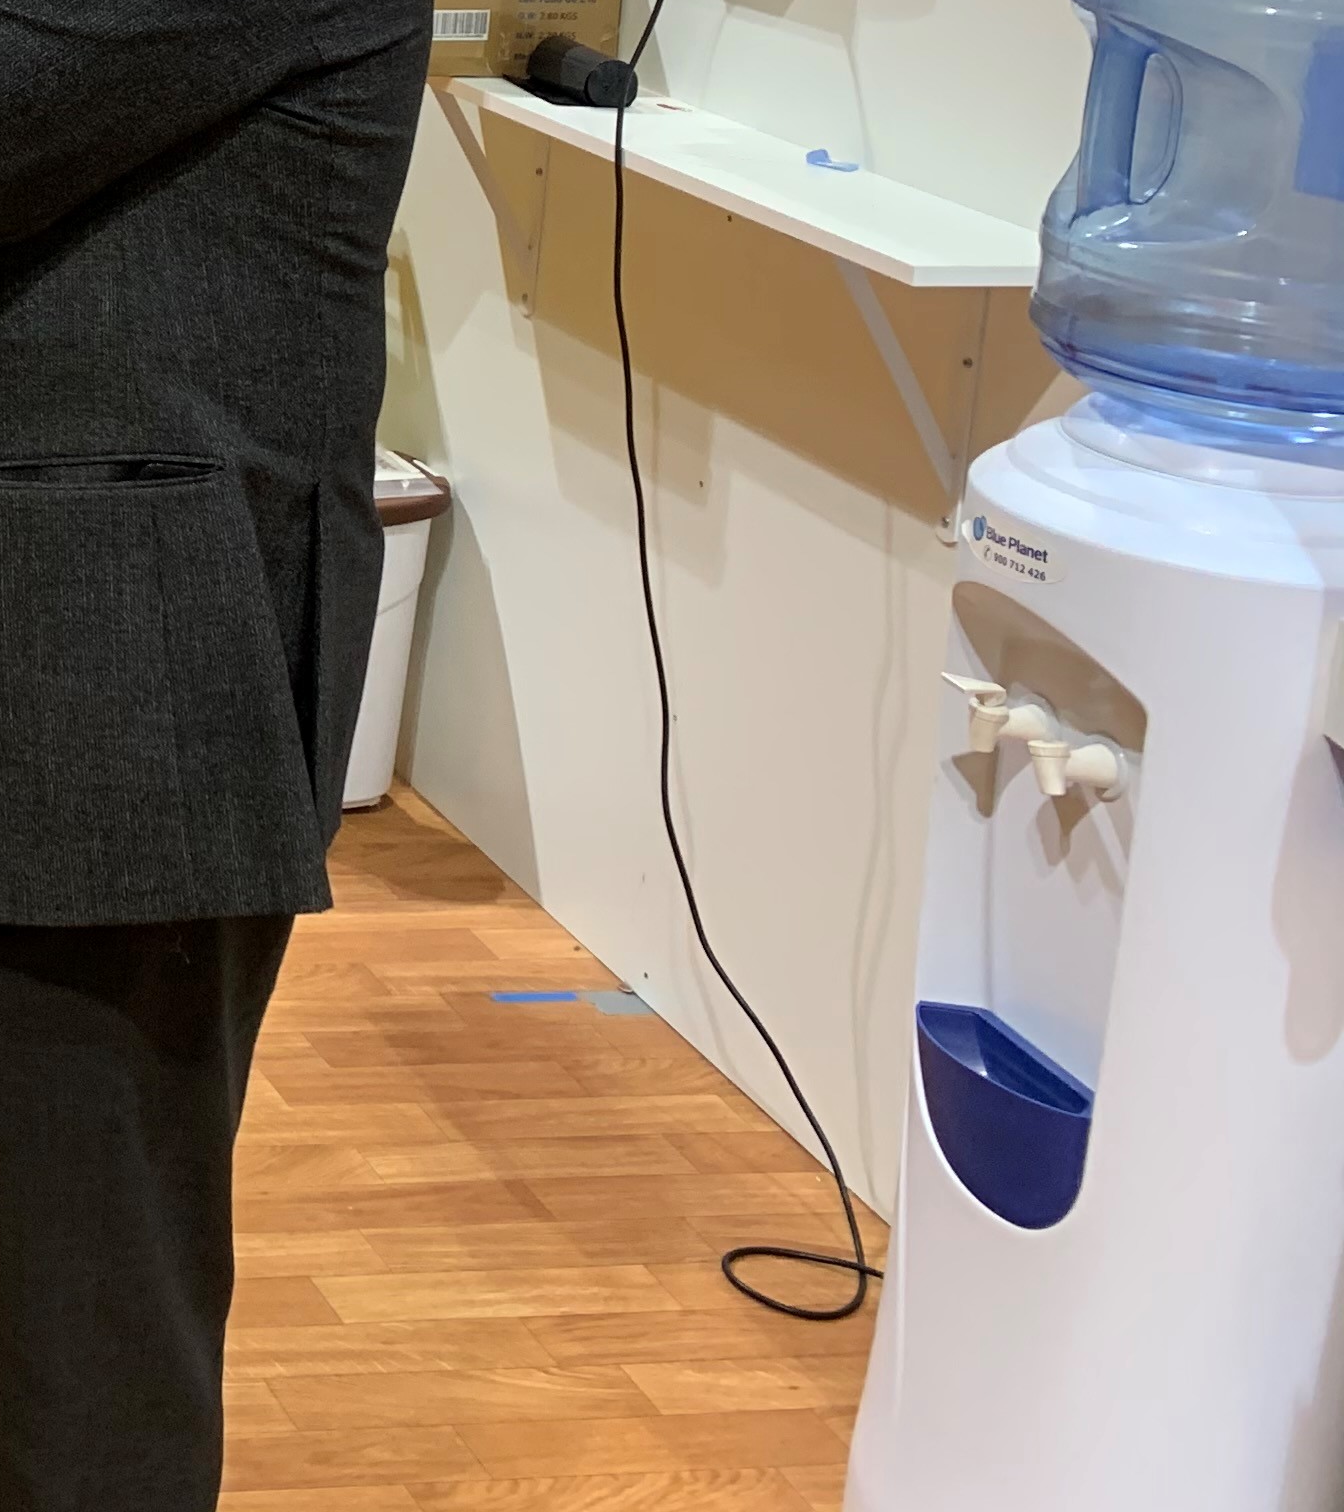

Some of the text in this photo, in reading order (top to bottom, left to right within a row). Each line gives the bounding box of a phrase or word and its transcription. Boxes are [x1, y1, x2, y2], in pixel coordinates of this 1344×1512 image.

[986, 526, 1048, 563] Blue Planet
[1010, 560, 1026, 574] 712
[1028, 568, 1046, 581] 426
